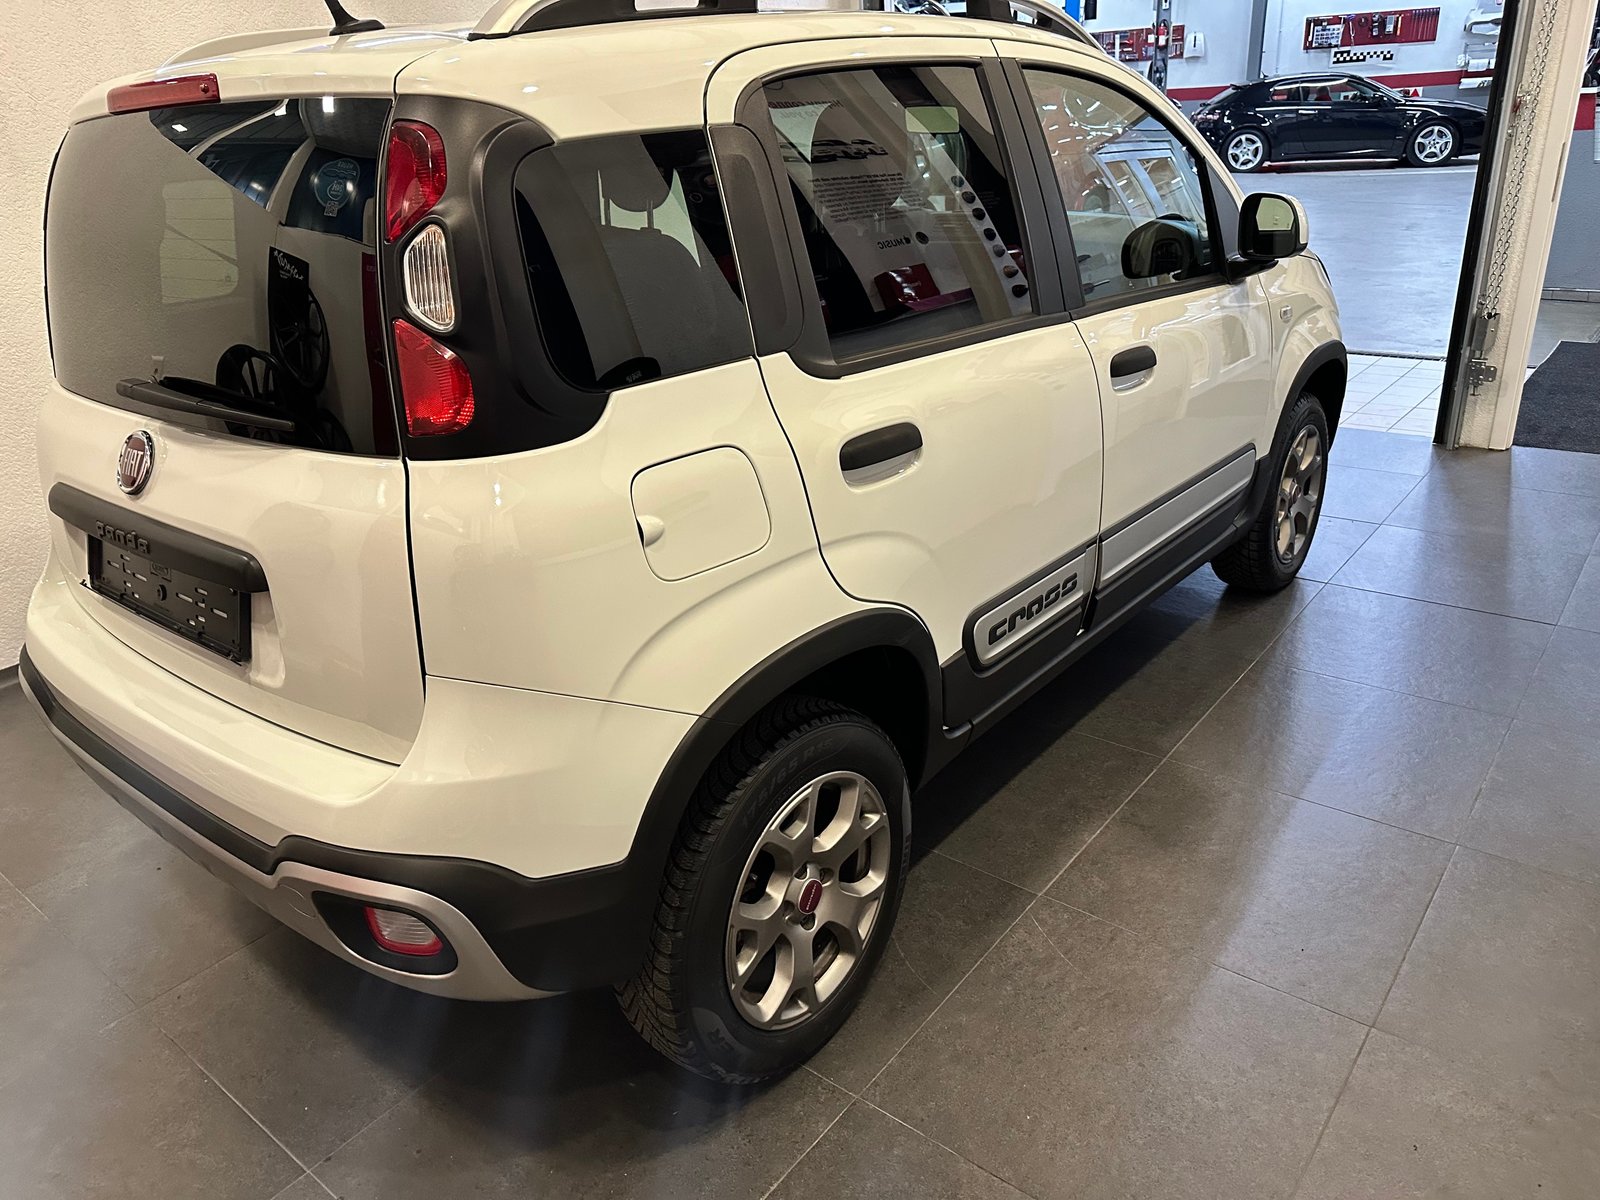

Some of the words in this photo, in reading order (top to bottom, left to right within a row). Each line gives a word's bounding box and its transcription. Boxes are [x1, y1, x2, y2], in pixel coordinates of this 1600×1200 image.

[122, 447, 144, 478] FIAT
[95, 520, 150, 553] panda
[988, 571, 1078, 646] cross
